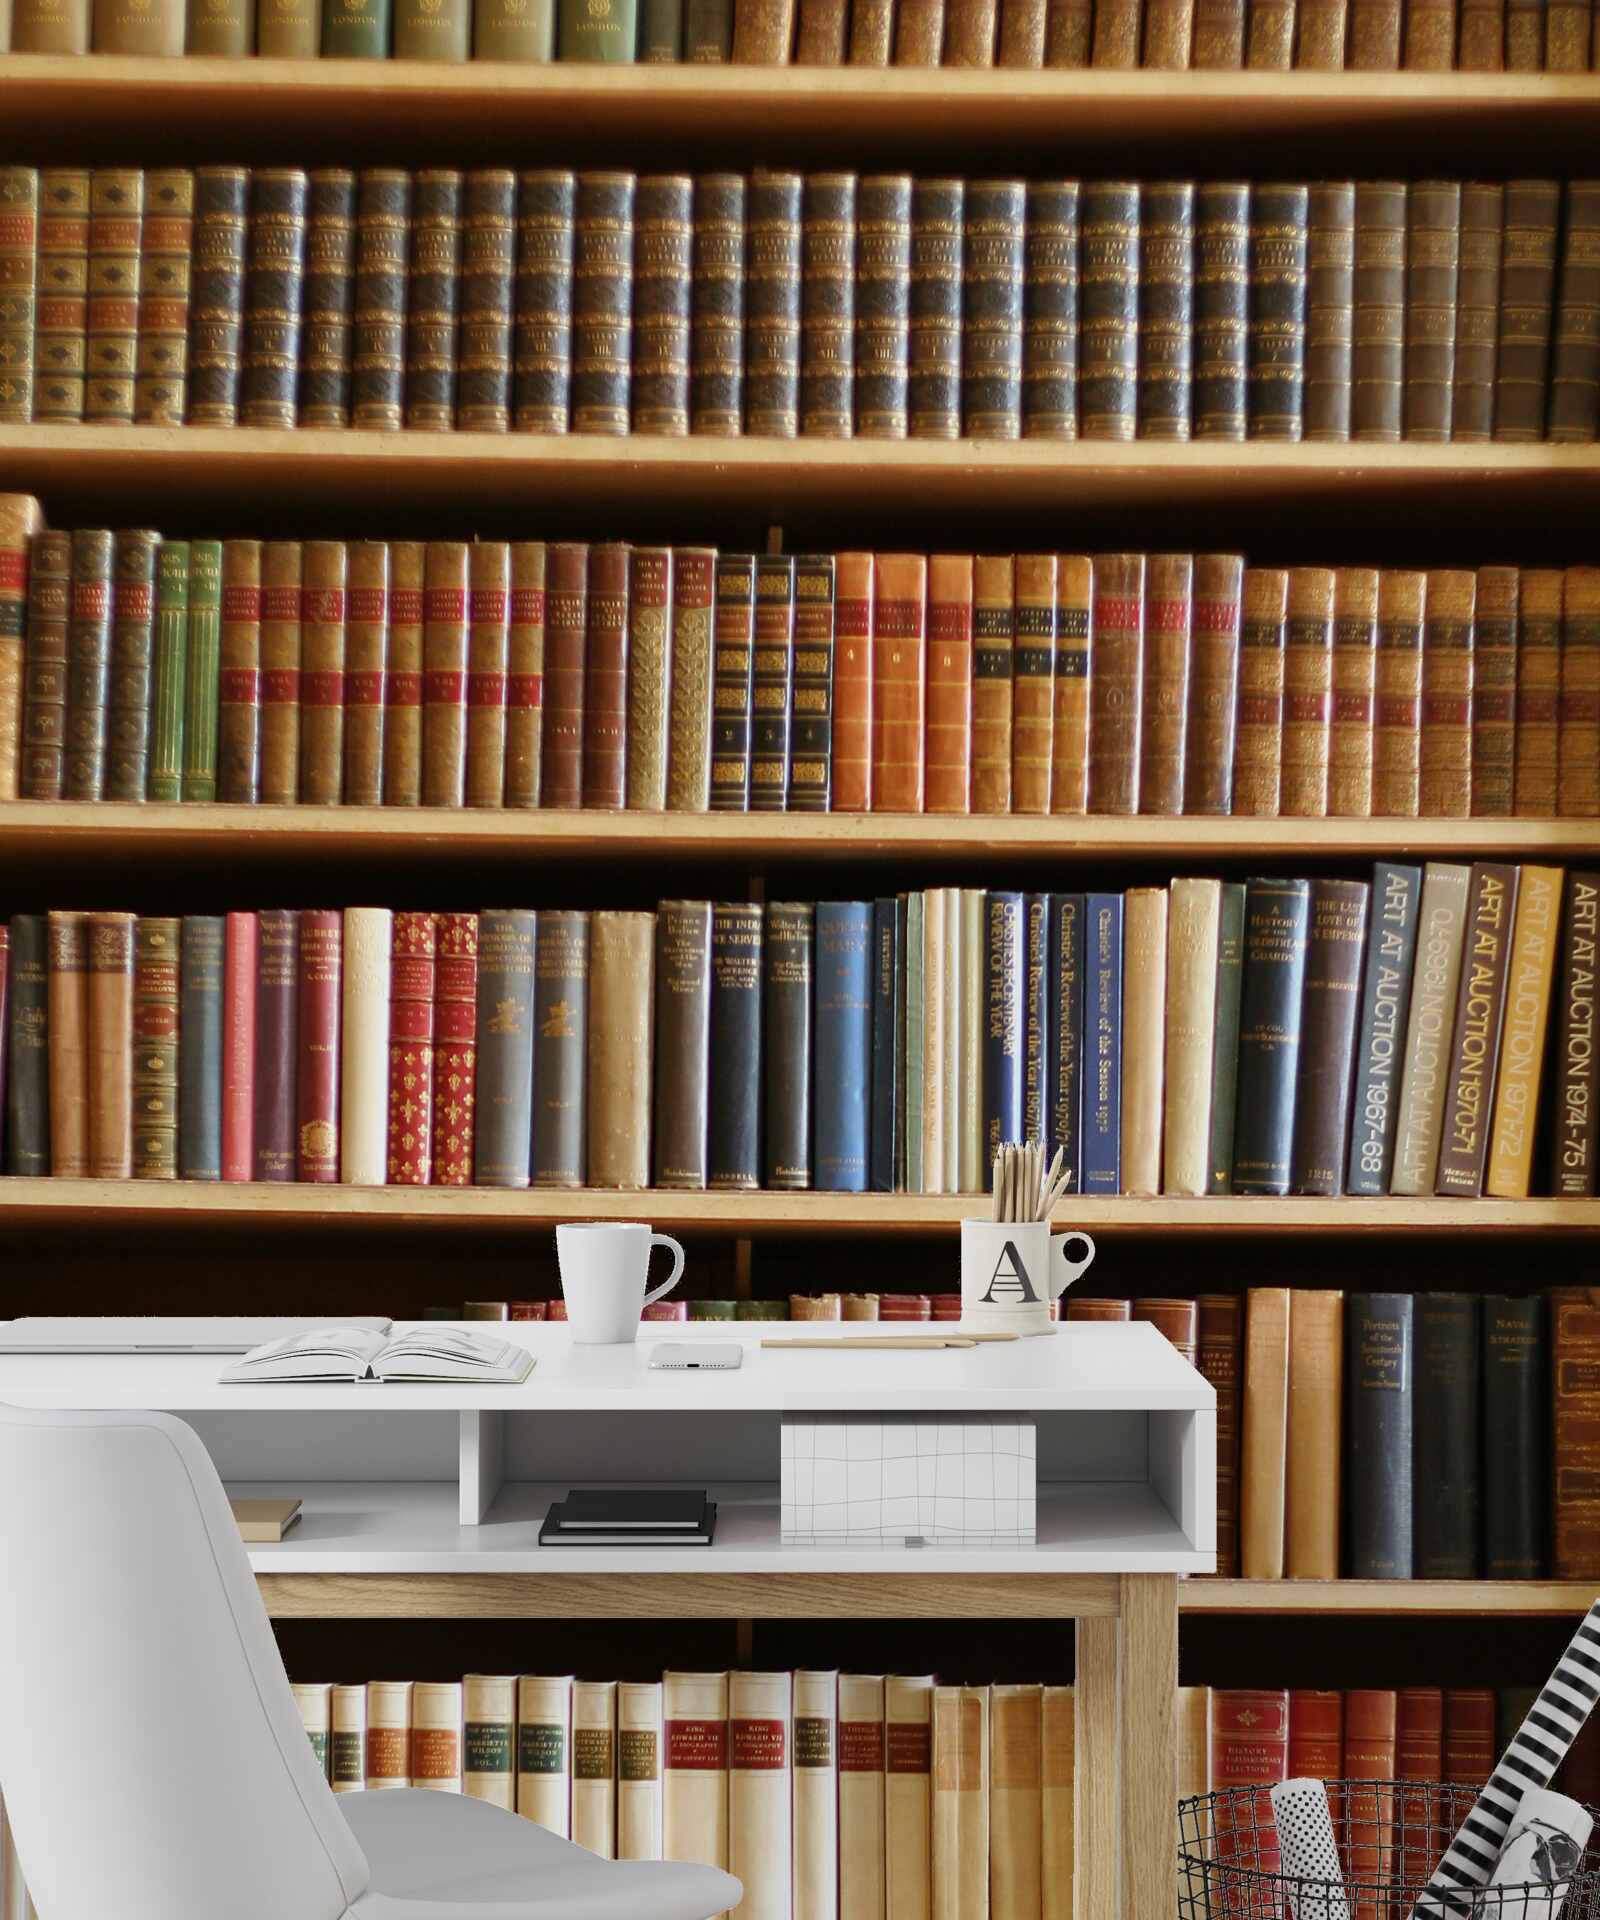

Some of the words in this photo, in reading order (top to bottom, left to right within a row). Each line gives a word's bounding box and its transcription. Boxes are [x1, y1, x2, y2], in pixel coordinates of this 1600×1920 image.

[332, 16, 377, 26] LONDON
[407, 17, 451, 27] LONDON
[576, 22, 623, 33] LONDON
[847, 649, 854, 661] 4
[1272, 905, 1280, 914] A
[1315, 900, 1338, 912] THE
[1384, 871, 1409, 927] ART
[1477, 874, 1504, 929] ART
[1526, 876, 1553, 931] ART
[1574, 882, 1598, 936] ART
[716, 919, 735, 930] THE
[990, 902, 1004, 953] REVIEW
[1029, 902, 1044, 963] Christie's
[1060, 903, 1076, 969] Christie's
[1099, 908, 1112, 965] Christie's
[1251, 914, 1299, 928] HISTORY
[1317, 914, 1344, 925] LOVE
[1346, 915, 1361, 926] OF
[1251, 951, 1296, 961] GUARDS
[1380, 929, 1404, 962] AT
[1474, 929, 1498, 963] AT
[1521, 928, 1546, 965] AT
[1572, 936, 1596, 967] AT
[990, 955, 1003, 974] OF
[990, 979, 1003, 1002] THE
[1029, 966, 1043, 1016] Review
[1060, 970, 1074, 1022] Review
[1098, 968, 1112, 1014] Review
[990, 1005, 1003, 1038] YEAR
[1027, 1018, 1041, 1032] of
[1060, 1024, 1074, 1041] of
[1098, 1017, 1112, 1033] of
[1369, 965, 1400, 1075] AUCTION
[1460, 963, 1495, 1075] AUCTION
[1508, 962, 1542, 1075] AUCTION
[1568, 967, 1594, 1077] AUCTION
[1027, 1035, 1041, 1057] the
[1060, 1042, 1074, 1061] the
[1098, 1035, 1112, 1055] the
[1411, 992, 1446, 1104] AUCTION
[1026, 1058, 1041, 1088] Year
[1060, 1062, 1073, 1095] Year
[1098, 1060, 1112, 1101] Season
[1360, 1080, 1389, 1172] 1967-68
[1407, 1103, 1433, 1136] AT
[1451, 1077, 1482, 1154] 1970-71
[1500, 1081, 1528, 1157] 1971-72
[1403, 1132, 1430, 1186] ART
[978, 1240, 1043, 1304] A
[1366, 1355, 1399, 1368] Century
[1225, 1765, 1270, 1773] ELECTIONS
